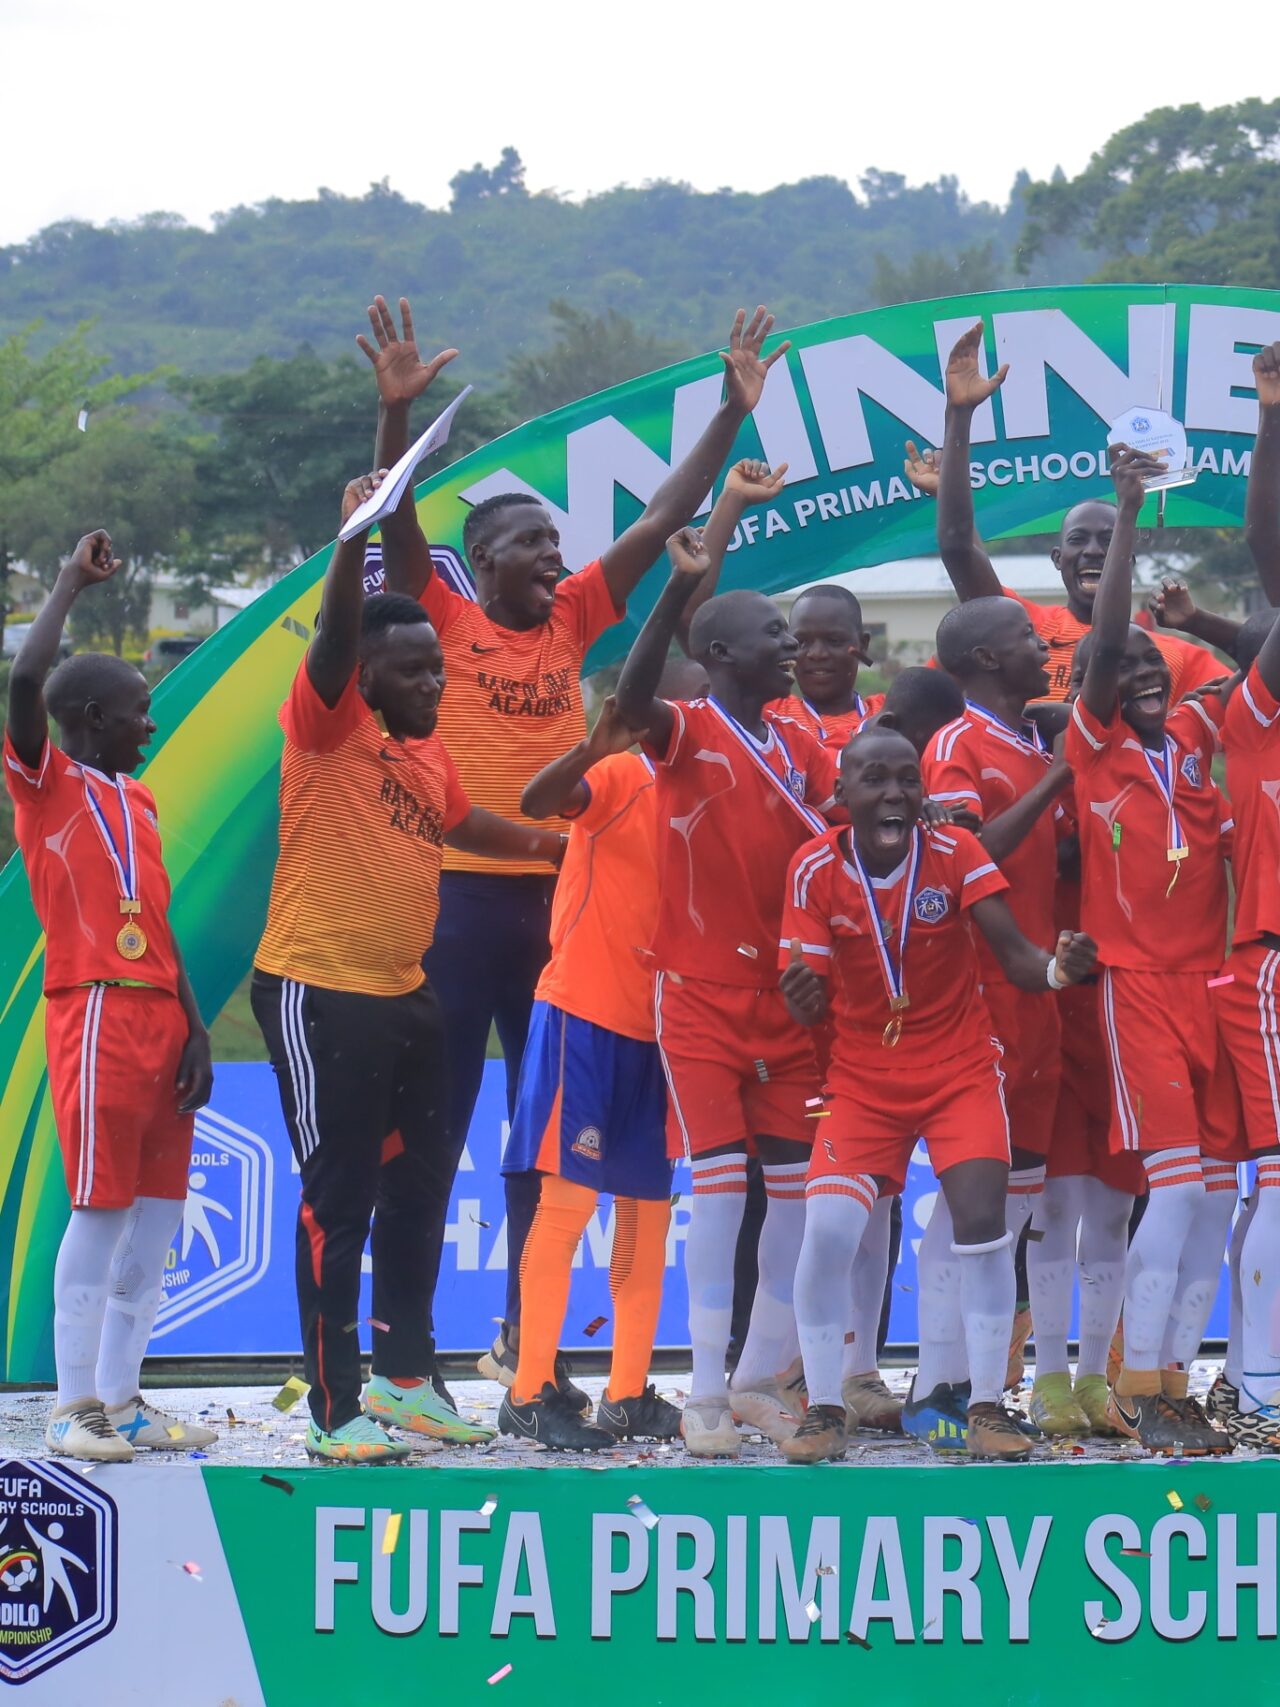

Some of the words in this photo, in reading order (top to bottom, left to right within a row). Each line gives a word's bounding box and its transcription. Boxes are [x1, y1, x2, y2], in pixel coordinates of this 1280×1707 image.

[970, 450, 1113, 489] SCHOOL
[20, 1502, 85, 1517] SCHOOLS
[313, 1506, 557, 1638] FUFA
[591, 1510, 1053, 1641] PRIMARY
[0, 1602, 40, 1627] DILO
